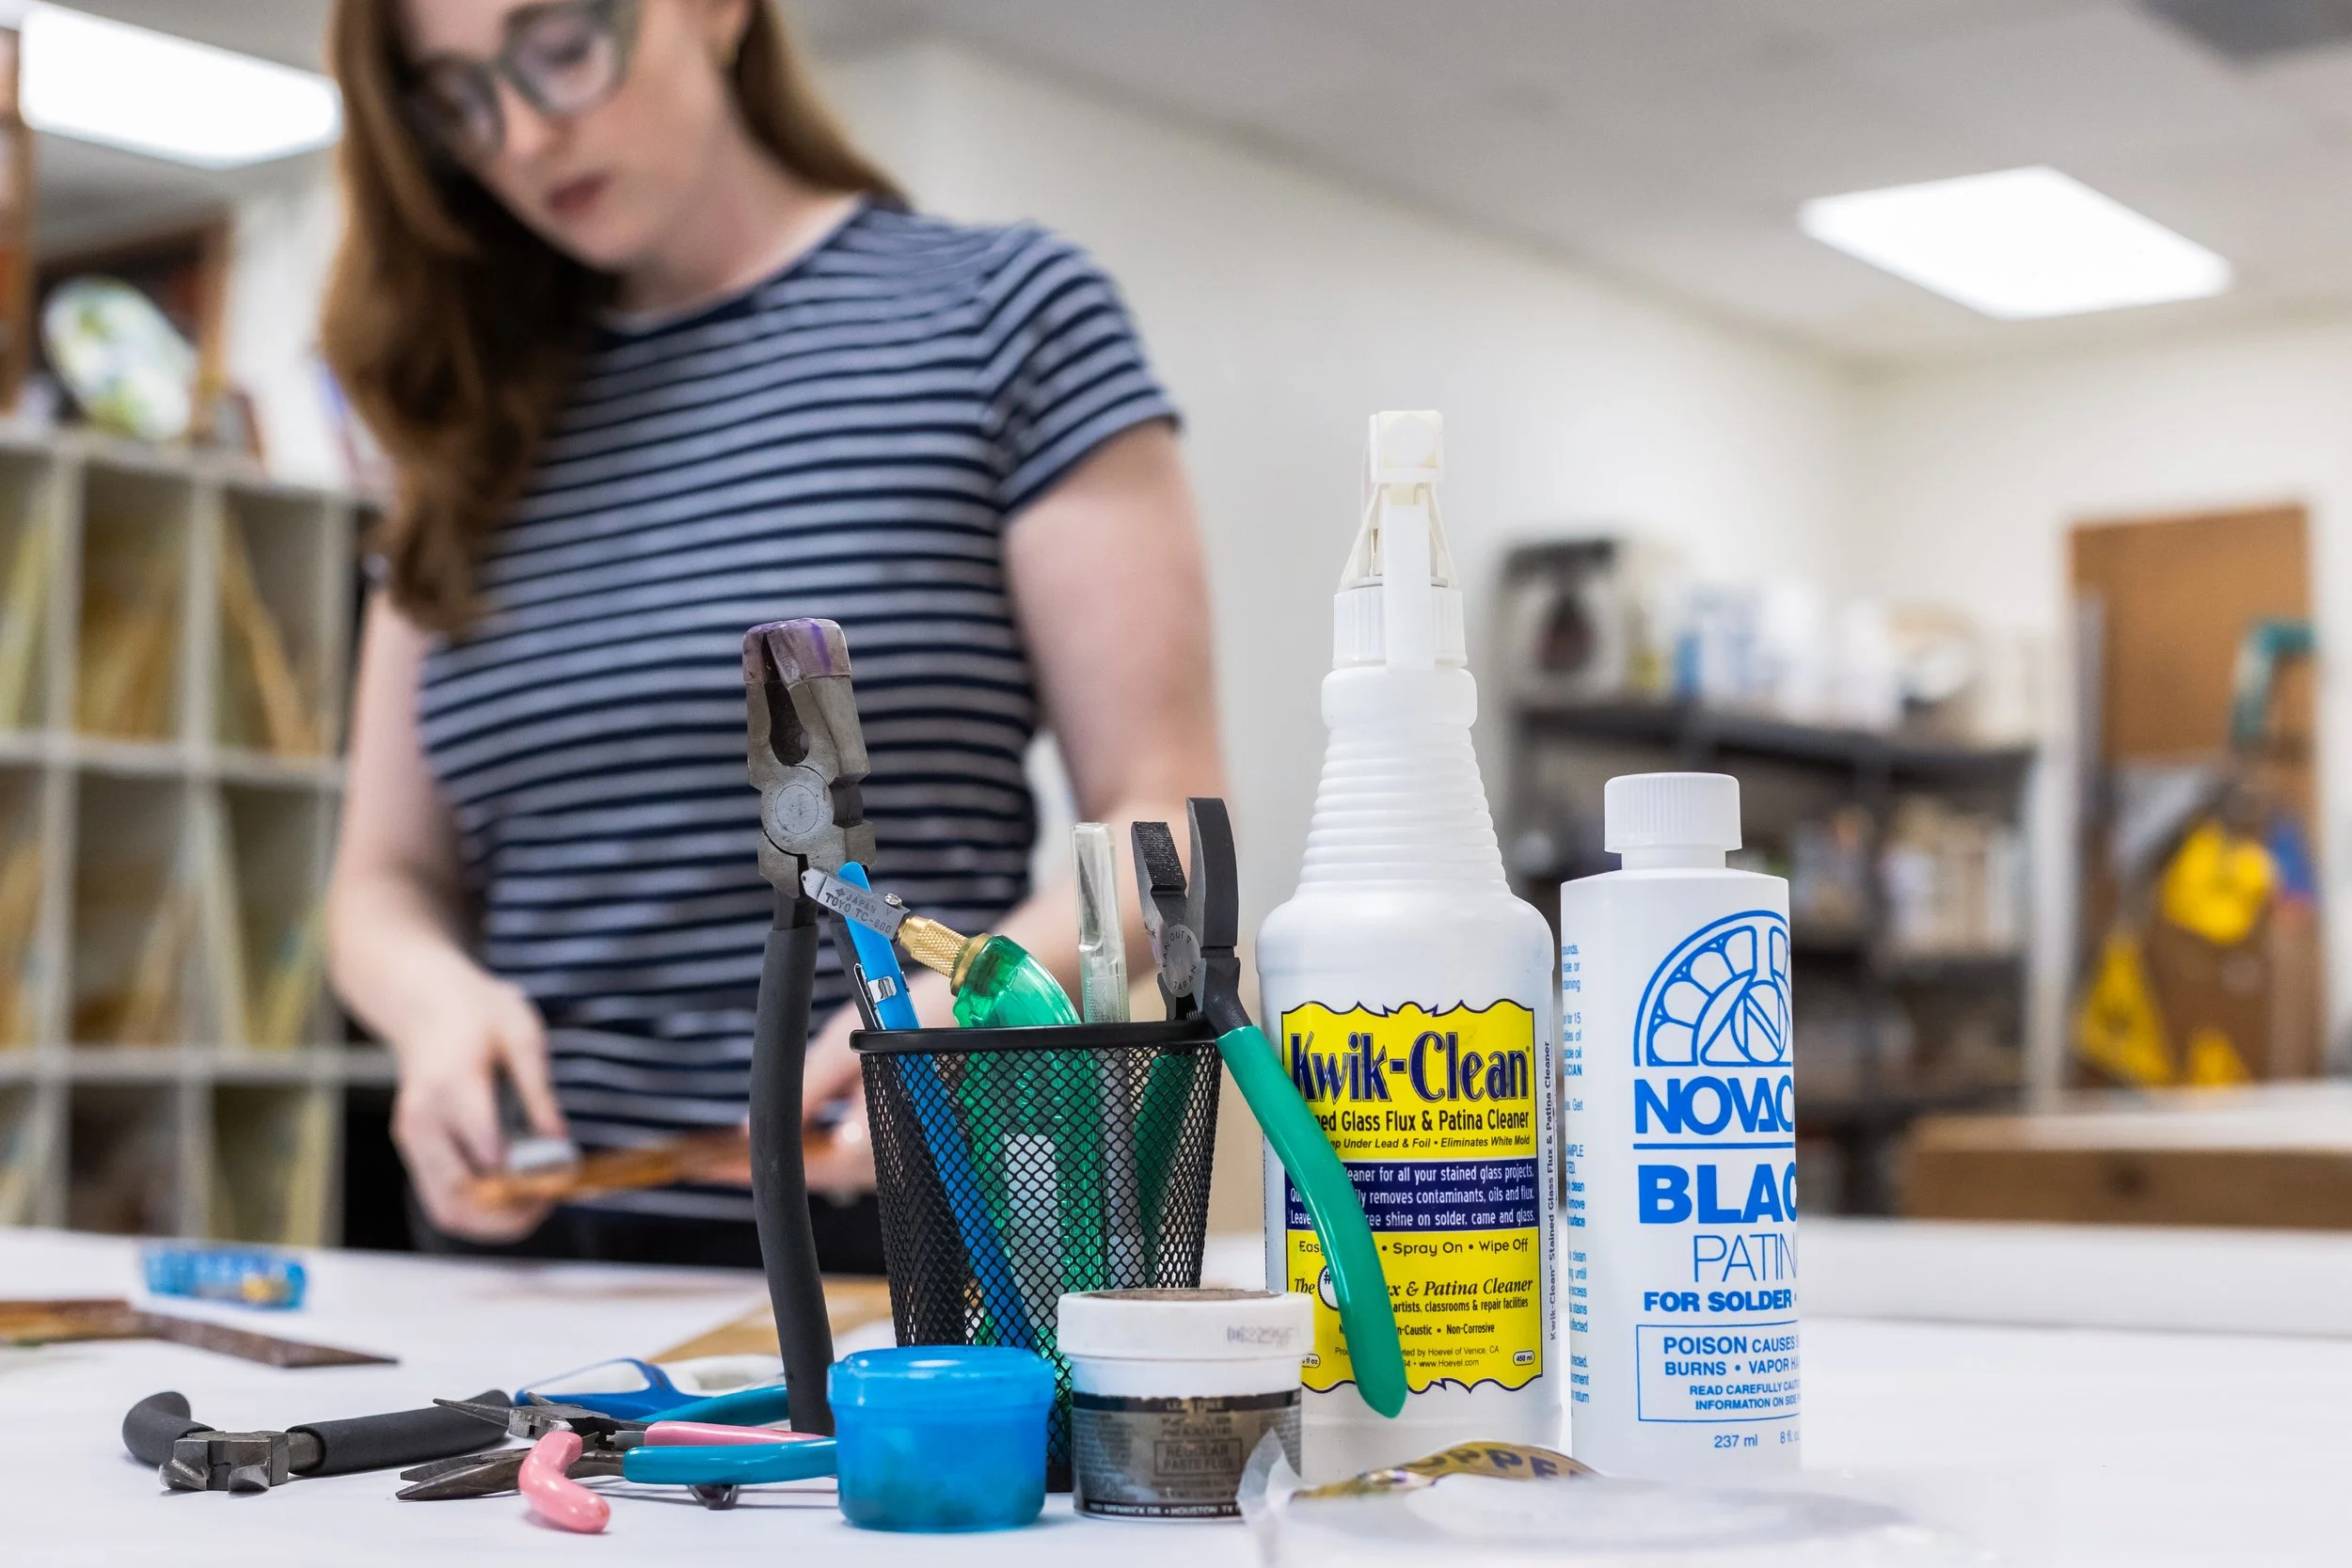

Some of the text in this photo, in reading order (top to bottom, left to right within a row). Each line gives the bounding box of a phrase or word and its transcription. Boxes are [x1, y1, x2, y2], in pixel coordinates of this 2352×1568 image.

[825, 892, 851, 914] TOYO
[847, 895, 877, 913] JAPAN
[1342, 1110, 1380, 1132] Glass
[1386, 1110, 1416, 1132] Flux
[1422, 1110, 1433, 1132] &
[1439, 1108, 1483, 1131] Patina
[1487, 1108, 1529, 1130] Cleaner
[1343, 1138, 1372, 1148] Under
[1375, 1138, 1399, 1148] Lead
[1402, 1137, 1409, 1148] &
[1412, 1137, 1430, 1148] Foil
[1440, 1137, 1488, 1148] Eliminates
[1491, 1134, 1512, 1147] White
[1515, 1134, 1531, 1146] Mold
[1547, 1134, 1553, 1145] &
[1345, 1163, 1534, 1186] eaner for all your stained glass projects.
[1370, 1191, 1413, 1205] removes
[1488, 1186, 1503, 1202] oils
[1505, 1186, 1519, 1201] and
[1521, 1184, 1534, 1199] flux.
[1290, 1210, 1312, 1225] Leave
[1386, 1211, 1413, 1227] shine
[1418, 1213, 1431, 1227] on
[1471, 1212, 1496, 1225] came
[1500, 1209, 1515, 1223] and
[1517, 1209, 1535, 1227] glass.
[1393, 1242, 1438, 1257] Spray
[1442, 1242, 1463, 1253] On
[1479, 1240, 1510, 1254] Wipe
[1513, 1238, 1529, 1252] Off
[1295, 1277, 1315, 1294] The
[1406, 1280, 1419, 1297] &
[1423, 1280, 1478, 1296] Patina
[1483, 1277, 1534, 1295] Cleaner
[1425, 1301, 1470, 1313] classrooms
[1472, 1299, 1478, 1310] &
[1481, 1299, 1501, 1313] repair
[1503, 1296, 1529, 1309] facilities
[1644, 1289, 1792, 1312] FOR SOLDER
[1446, 1323, 1495, 1335] Non-Corrosive
[1417, 1348, 1426, 1358] by
[1428, 1347, 1453, 1356] Hoevel
[1454, 1346, 1462, 1355] of
[1489, 1345, 1500, 1354] CA
[1663, 1336, 1747, 1354] POISON
[1752, 1335, 1795, 1354] CAUSES
[1419, 1359, 1479, 1368] www.Hoevel.com
[1664, 1361, 1726, 1376] BURNS
[1749, 1357, 1789, 1374] VAPOR
[1690, 1385, 1724, 1396] READ
[1725, 1382, 1783, 1395] CAREFULLY
[1695, 1398, 1771, 1410] INFORMATION
[1772, 1397, 1784, 1407] ON
[1714, 1433, 1758, 1449] 237 ml
[1780, 1431, 1786, 1445] 8
